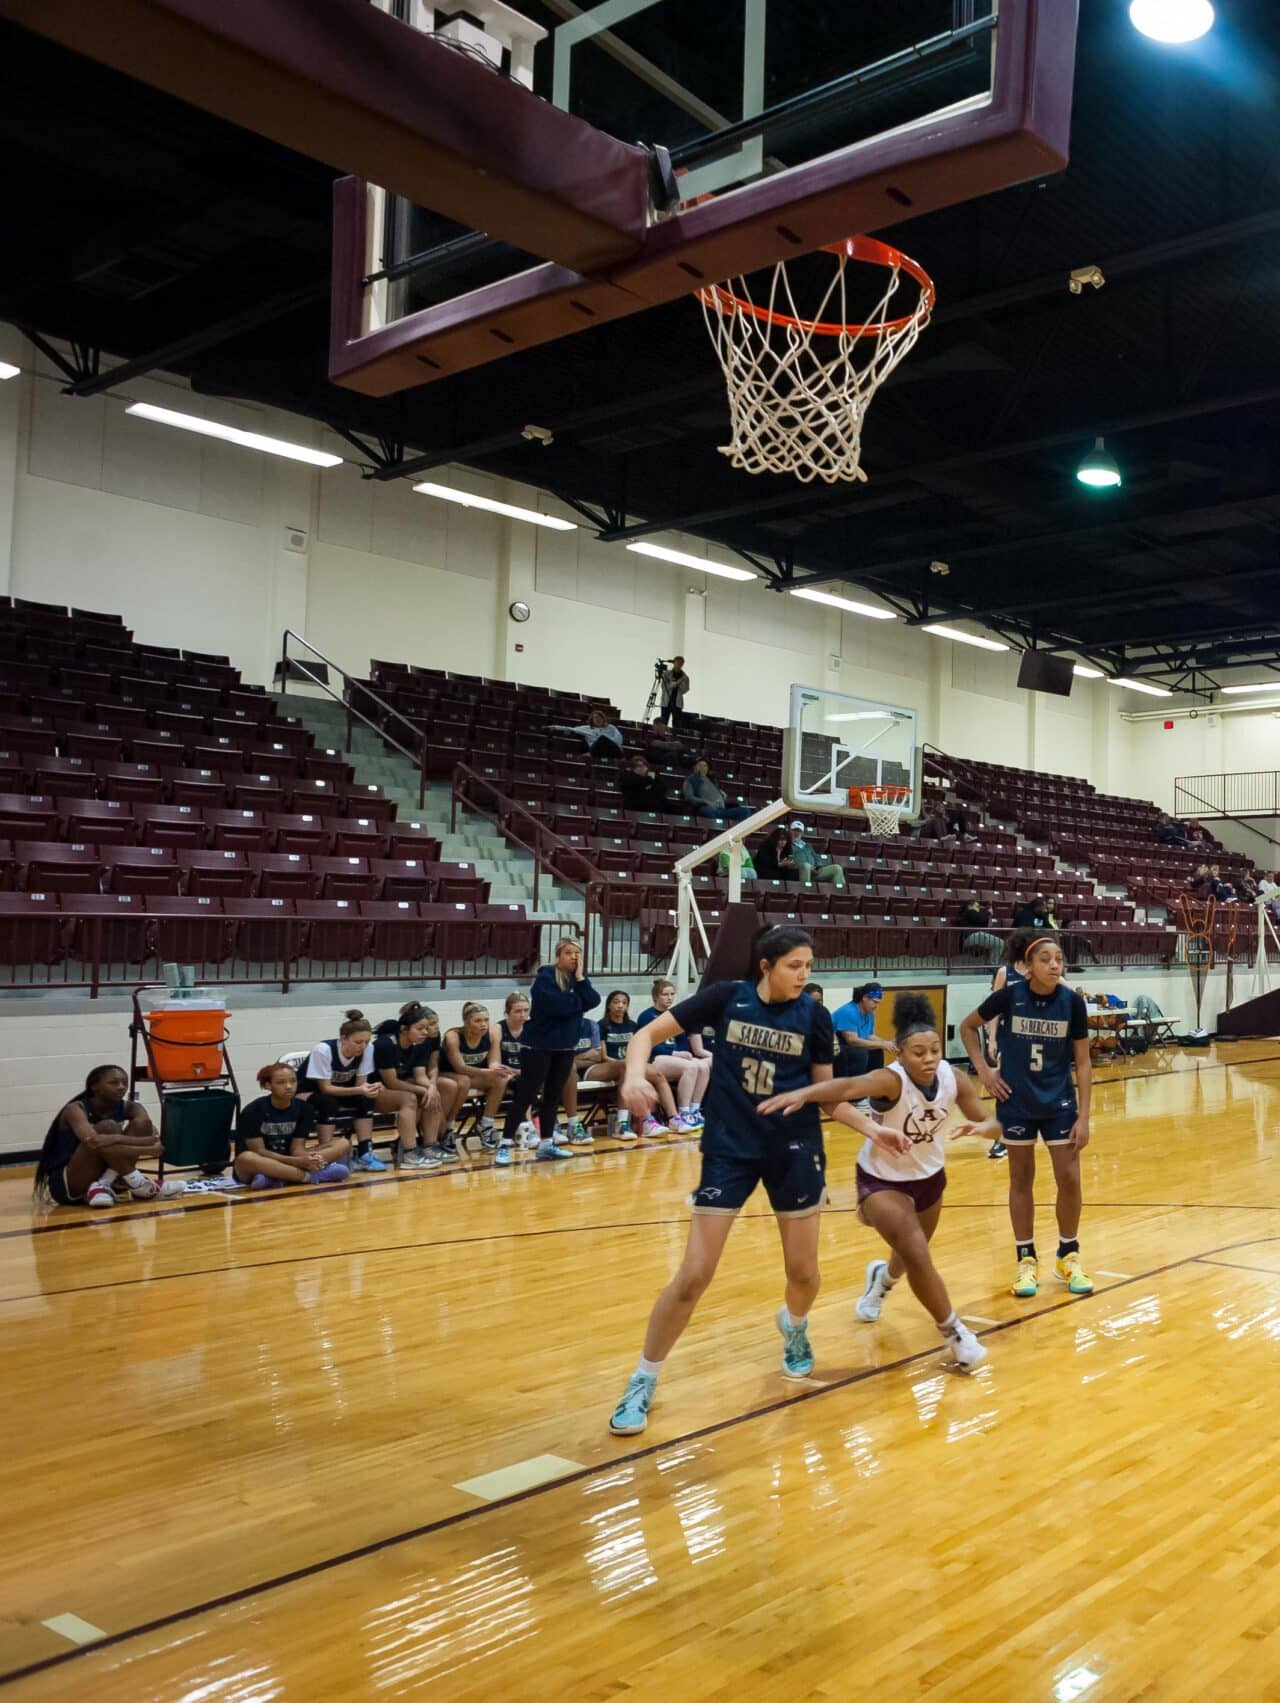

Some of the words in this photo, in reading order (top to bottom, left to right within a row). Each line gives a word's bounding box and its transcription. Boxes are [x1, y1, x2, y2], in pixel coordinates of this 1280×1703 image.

[739, 1025, 793, 1052] SABERCATS
[1020, 1019, 1058, 1036] SABERCATS
[1029, 1043, 1044, 1072] 5
[741, 1056, 776, 1095] 30
[919, 1108, 938, 1122] A
